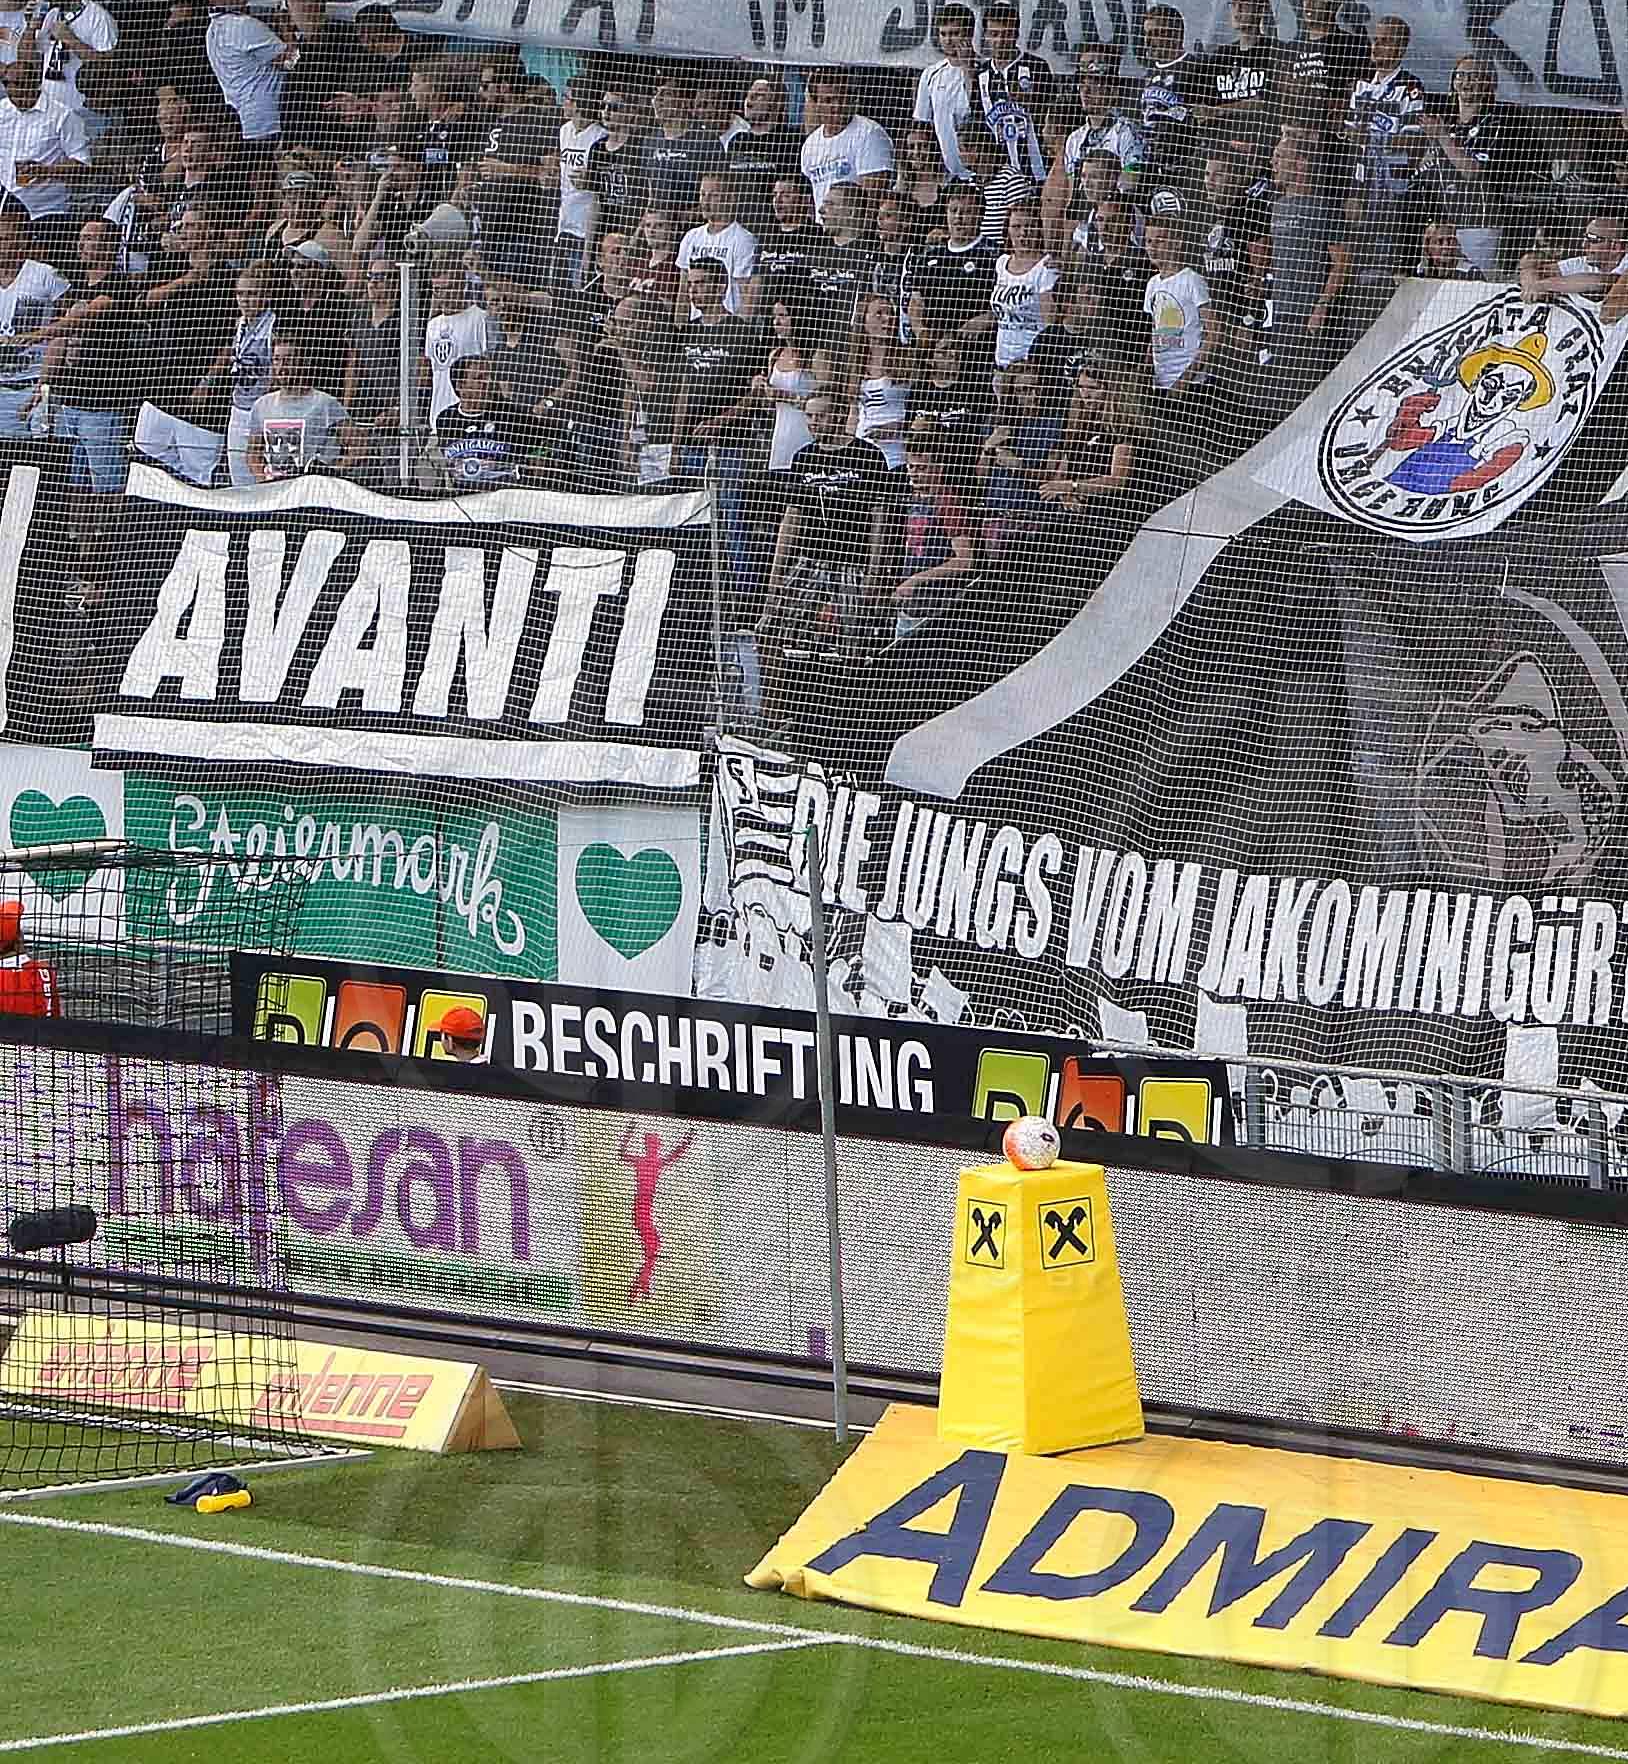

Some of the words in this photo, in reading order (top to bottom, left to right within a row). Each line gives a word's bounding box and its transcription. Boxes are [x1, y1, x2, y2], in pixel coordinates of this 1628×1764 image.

[118, 528, 678, 726] AVANTI
[794, 776, 882, 914] DIE
[878, 796, 1062, 959] JUNGS
[1065, 847, 1202, 984] VOM
[105, 1054, 530, 1292] hafesan
